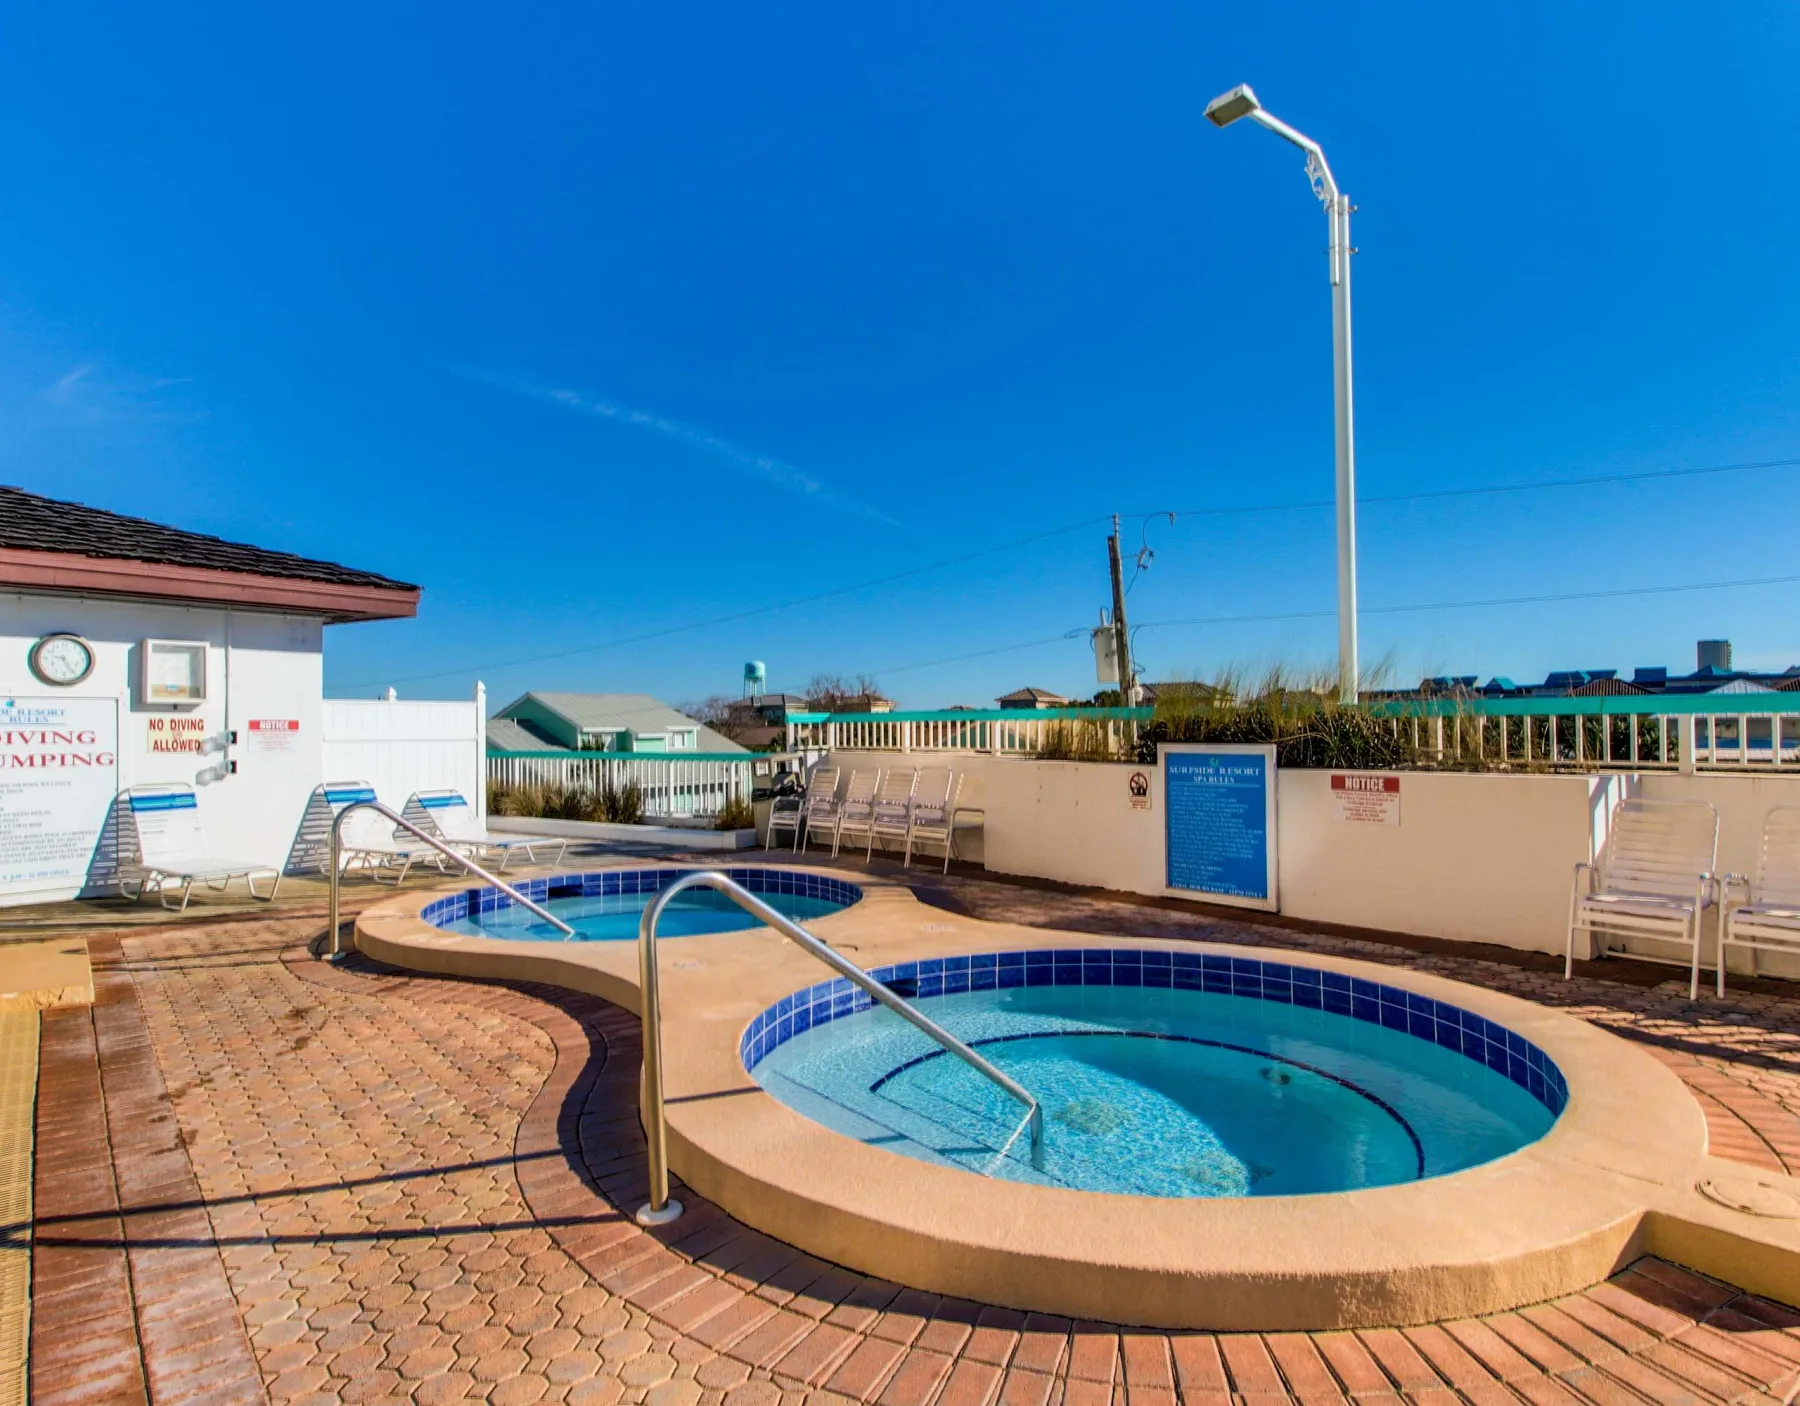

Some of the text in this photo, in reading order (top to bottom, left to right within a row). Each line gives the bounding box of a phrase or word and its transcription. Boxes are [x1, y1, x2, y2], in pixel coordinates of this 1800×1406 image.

[149, 718, 204, 731] NO DIVING
[260, 720, 289, 730] NOTICE
[0, 730, 97, 745] IVING
[153, 739, 202, 752] ALLOWED
[1169, 766, 1261, 776] SURFSIDE RESORT
[1345, 777, 1385, 791] NOTICE
